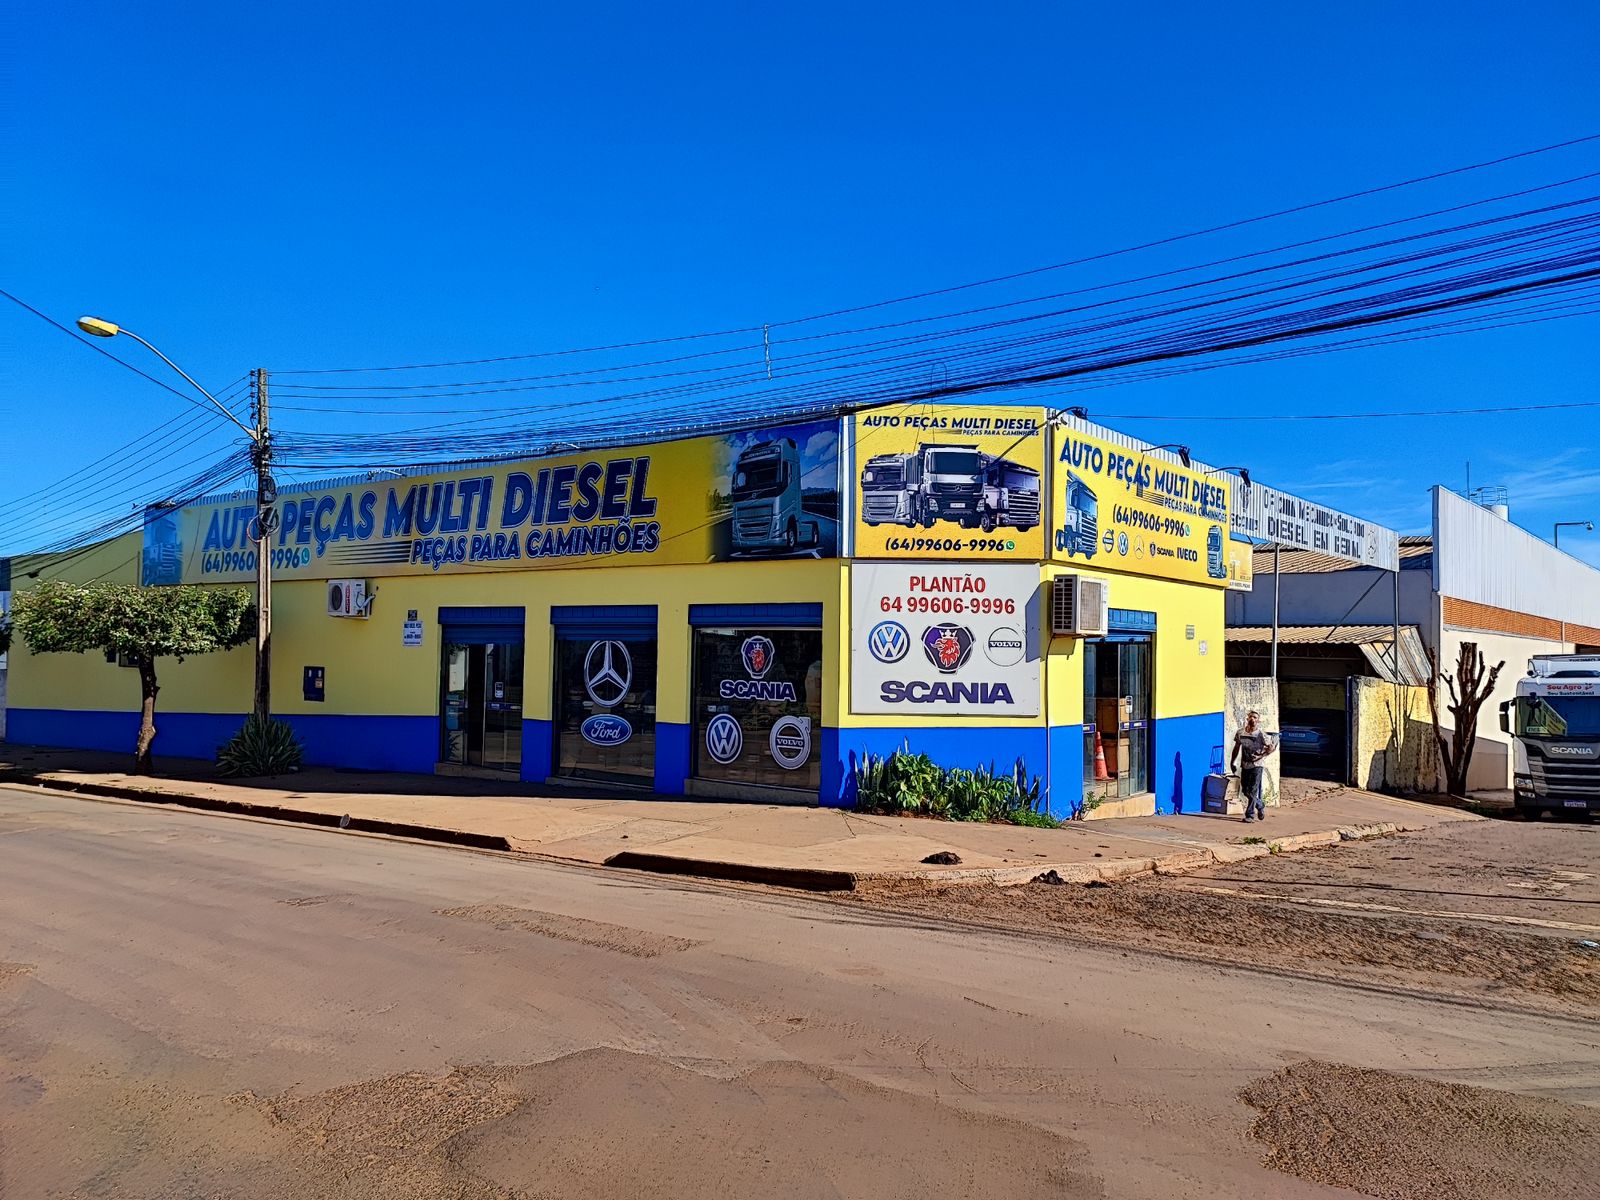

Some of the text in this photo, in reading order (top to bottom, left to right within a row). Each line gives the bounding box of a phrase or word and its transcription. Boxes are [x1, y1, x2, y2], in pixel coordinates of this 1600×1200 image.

[863, 416, 1038, 431] AUTO PEÇAS MULTI DIESEL
[1059, 437, 1226, 510] AUTO PEÇAS MULTI DIESEL
[278, 490, 378, 558] PEÇAS
[382, 475, 494, 538] MULTI
[501, 456, 658, 529] DIESEL
[1164, 497, 1182, 512] PEÇAS
[1183, 502, 1197, 515] PARA
[1264, 489, 1296, 518] OFCINA
[1112, 504, 1185, 537] (64)99606-9996
[1267, 516, 1308, 546] DIESEL
[411, 517, 660, 571] PEÇAS PARA CAMINHÕES
[885, 537, 1005, 552] (64)99606-9996
[1157, 547, 1174, 557] SCANIA
[1177, 547, 1198, 562] IVECO
[202, 547, 301, 574] (64)99609996
[909, 573, 986, 593] PLANTÃO
[880, 596, 1015, 614] 64 99606-9996
[720, 680, 796, 702] SCANIA
[880, 681, 1015, 704] SCANIA
[590, 719, 621, 740] Ford
[777, 738, 804, 747] VOLVO
[1551, 746, 1594, 755] SCANIA
